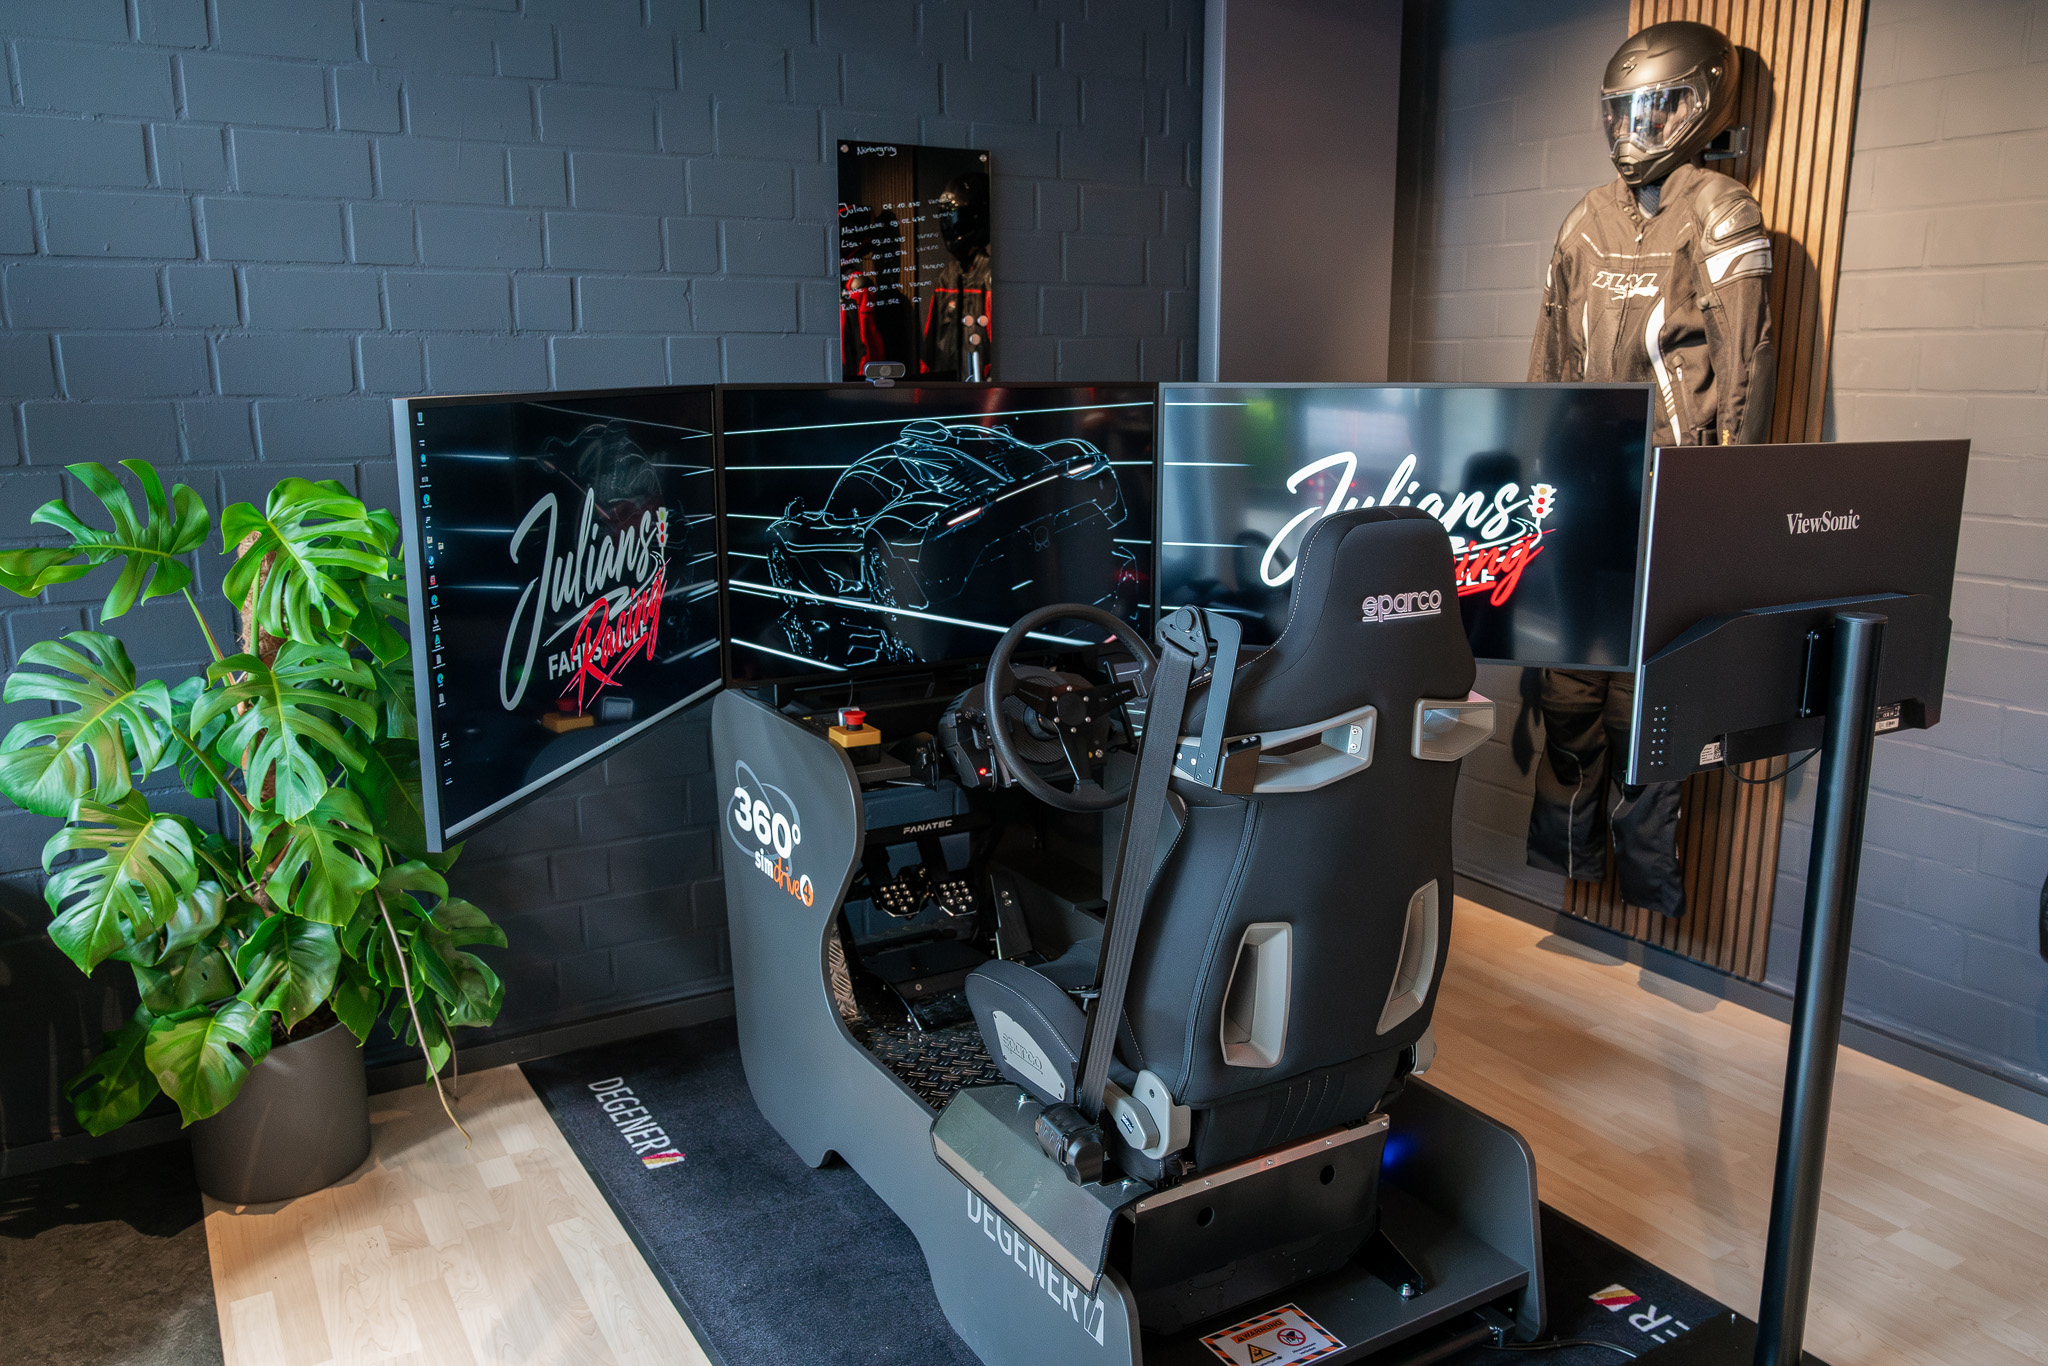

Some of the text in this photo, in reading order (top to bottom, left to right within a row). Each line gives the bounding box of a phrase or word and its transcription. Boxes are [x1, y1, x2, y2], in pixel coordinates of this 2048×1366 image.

[1786, 509, 1860, 535] ViewSonic
[500, 487, 657, 711] Julians
[1362, 589, 1442, 622] sparco
[562, 572, 668, 717] Racing
[903, 819, 952, 835] FANATEC
[588, 1076, 671, 1155] DEGENER
